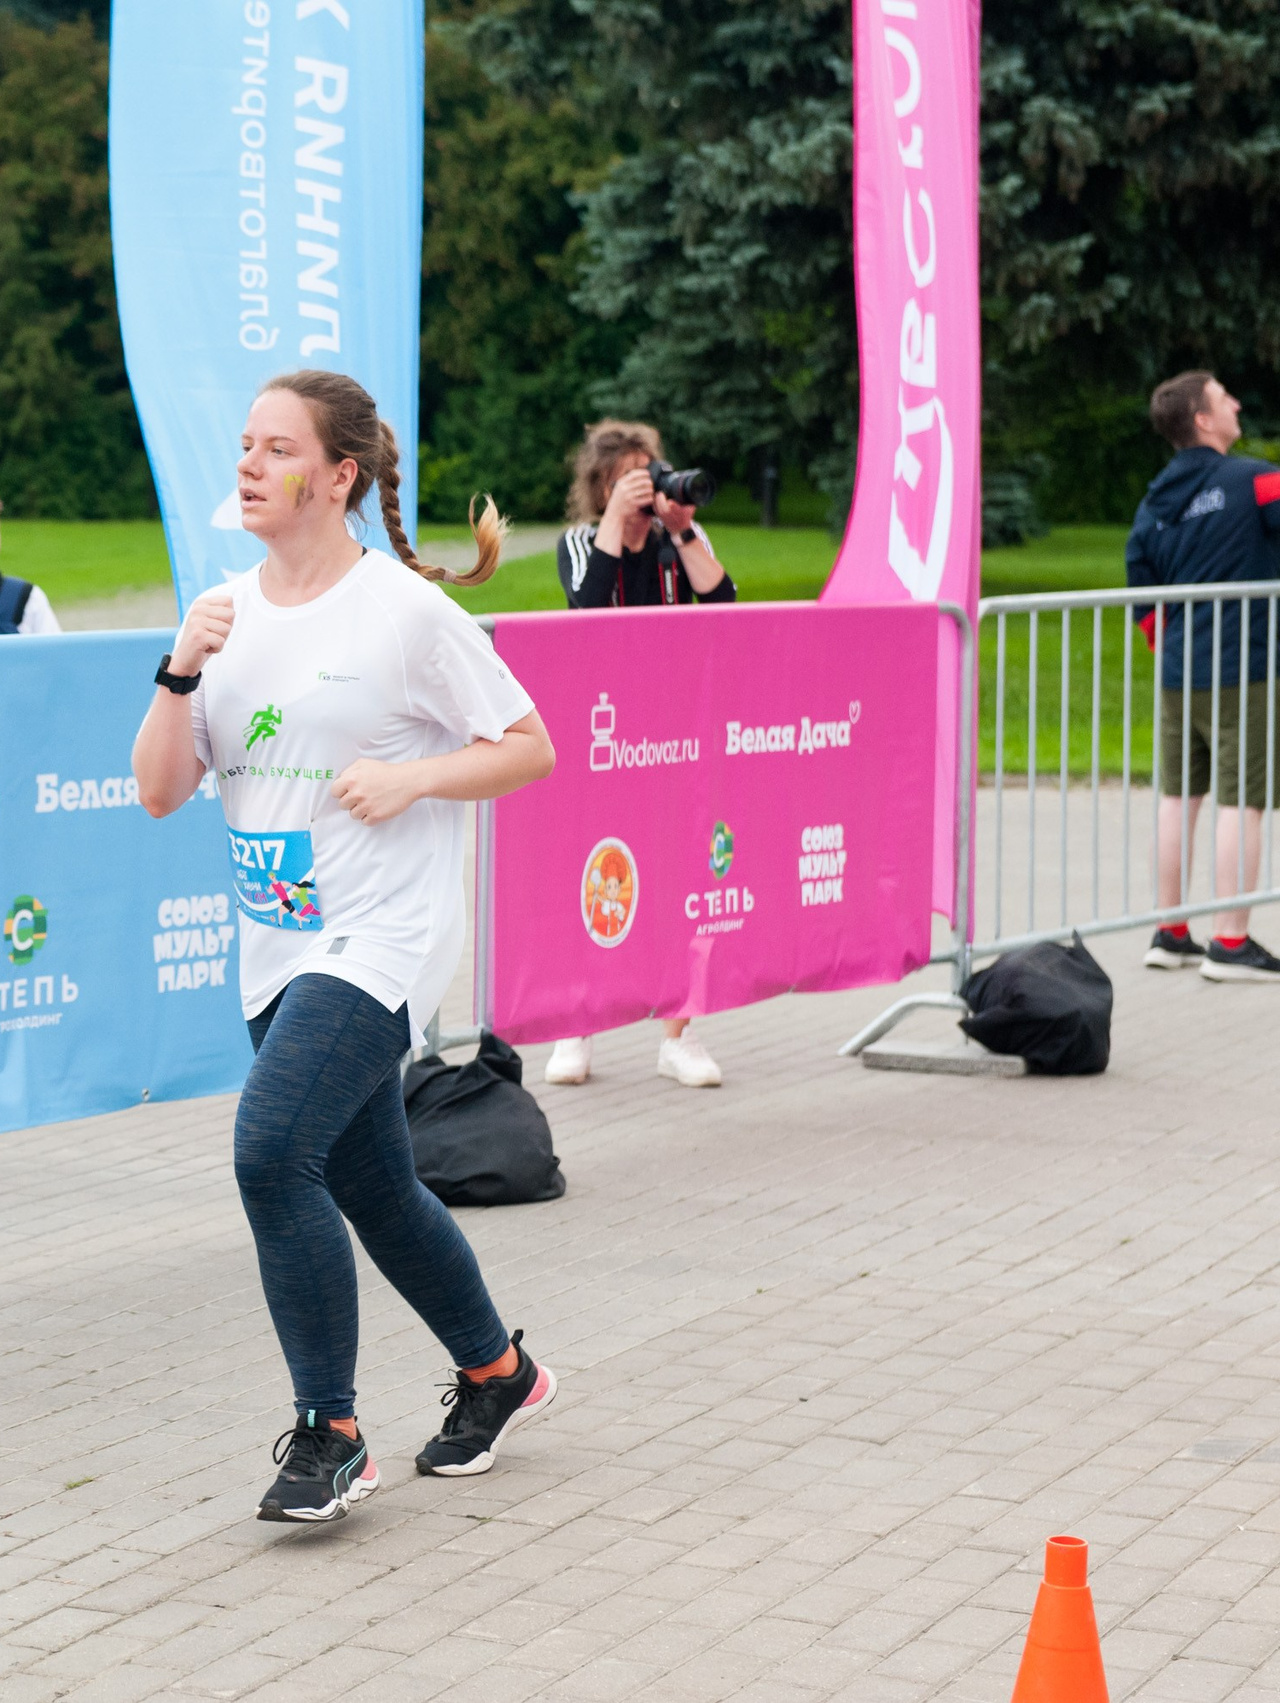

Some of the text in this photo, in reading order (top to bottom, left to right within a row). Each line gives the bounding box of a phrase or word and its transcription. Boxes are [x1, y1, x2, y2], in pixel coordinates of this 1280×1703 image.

[725, 716, 851, 755] Белая Дача
[614, 737, 699, 769] Vodovoz.ru
[250, 766, 264, 777] ЗА
[271, 767, 334, 780] БУДУЩЕЕ
[35, 773, 141, 813] Белая
[228, 832, 286, 870] 3217
[801, 823, 844, 853] СОЮЗ
[798, 850, 847, 881] МУЛЬТ
[685, 886, 754, 919] СТЕПЬ
[801, 877, 844, 907] ПАРК
[158, 893, 228, 929] СОЮЗ
[153, 925, 234, 963] МУЛЬТ
[158, 957, 228, 993] ПАРК
